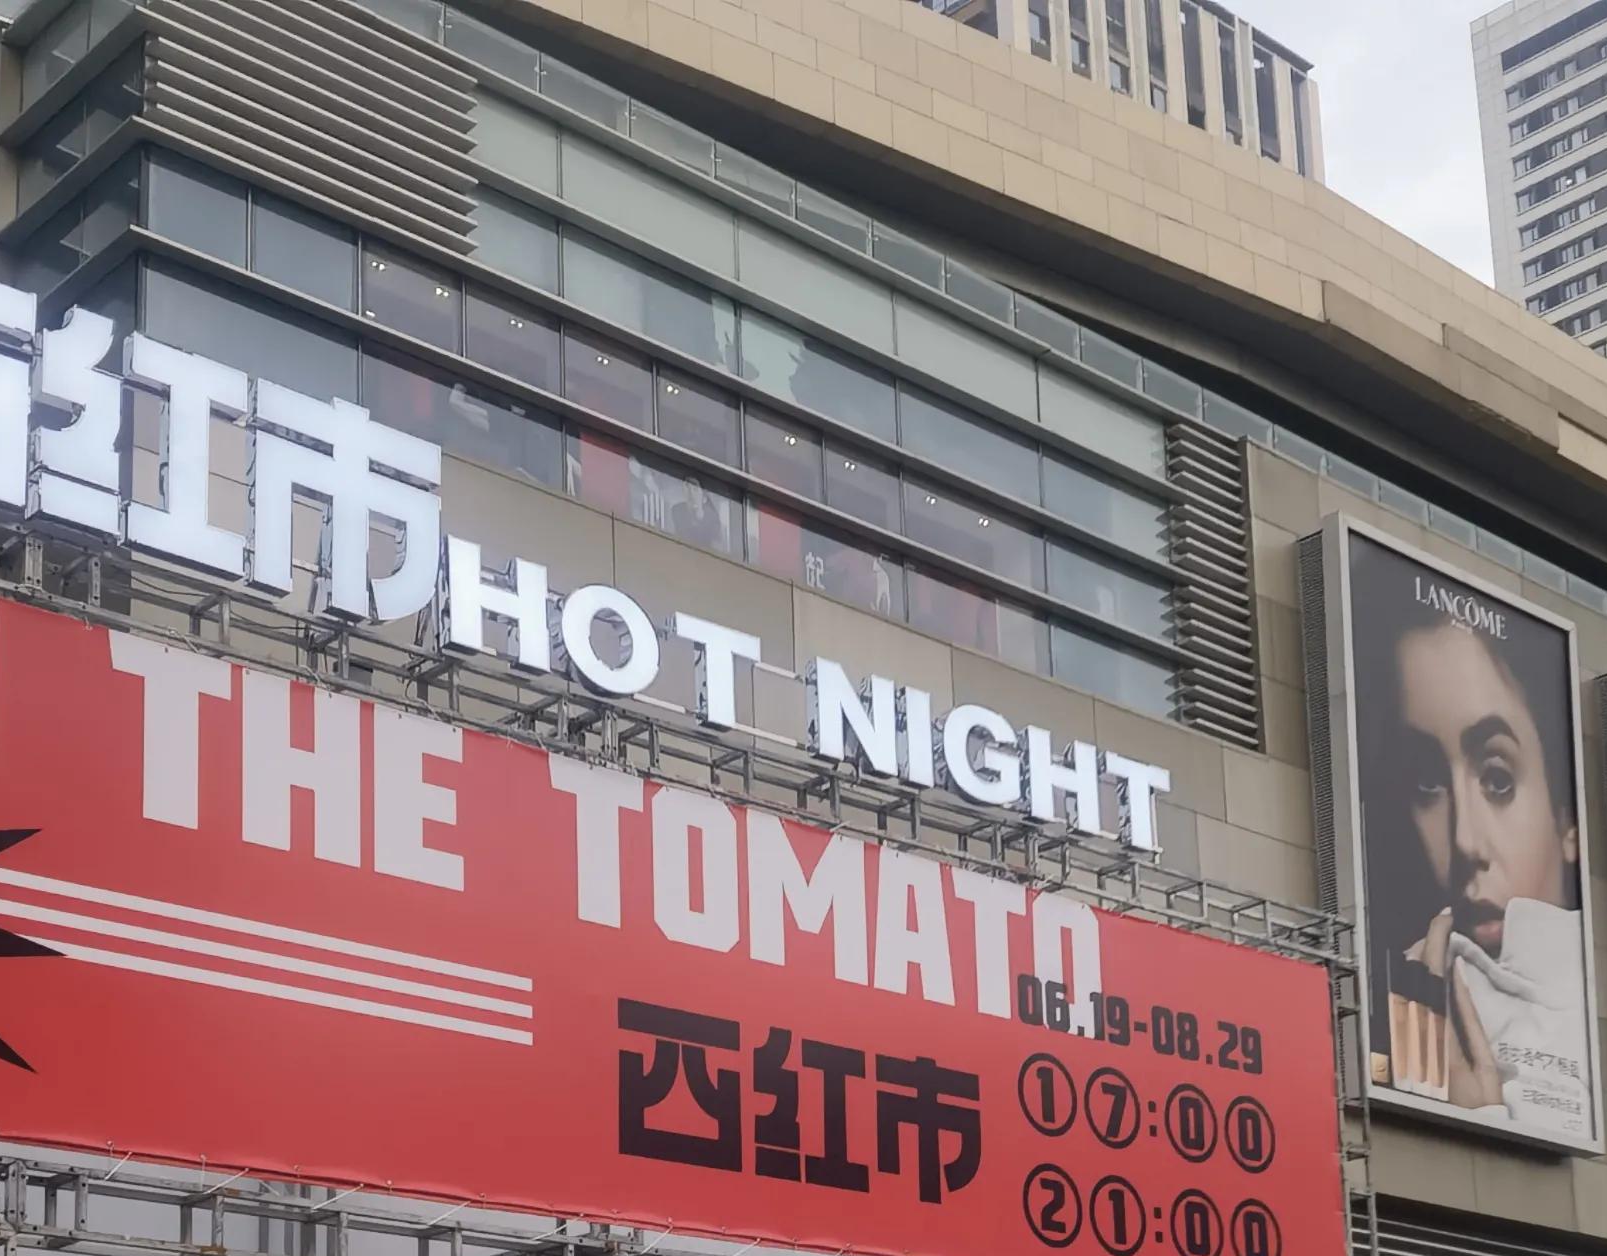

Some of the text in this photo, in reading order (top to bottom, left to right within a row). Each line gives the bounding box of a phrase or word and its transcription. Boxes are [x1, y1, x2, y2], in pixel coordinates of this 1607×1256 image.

[444, 535, 760, 730] HOT
[809, 658, 1170, 853] NIGHT
[1415, 576, 1507, 640] LANCÔME
[109, 628, 465, 892] THE
[547, 750, 1101, 1038] TOMATO
[617, 997, 981, 1205] 西红市
